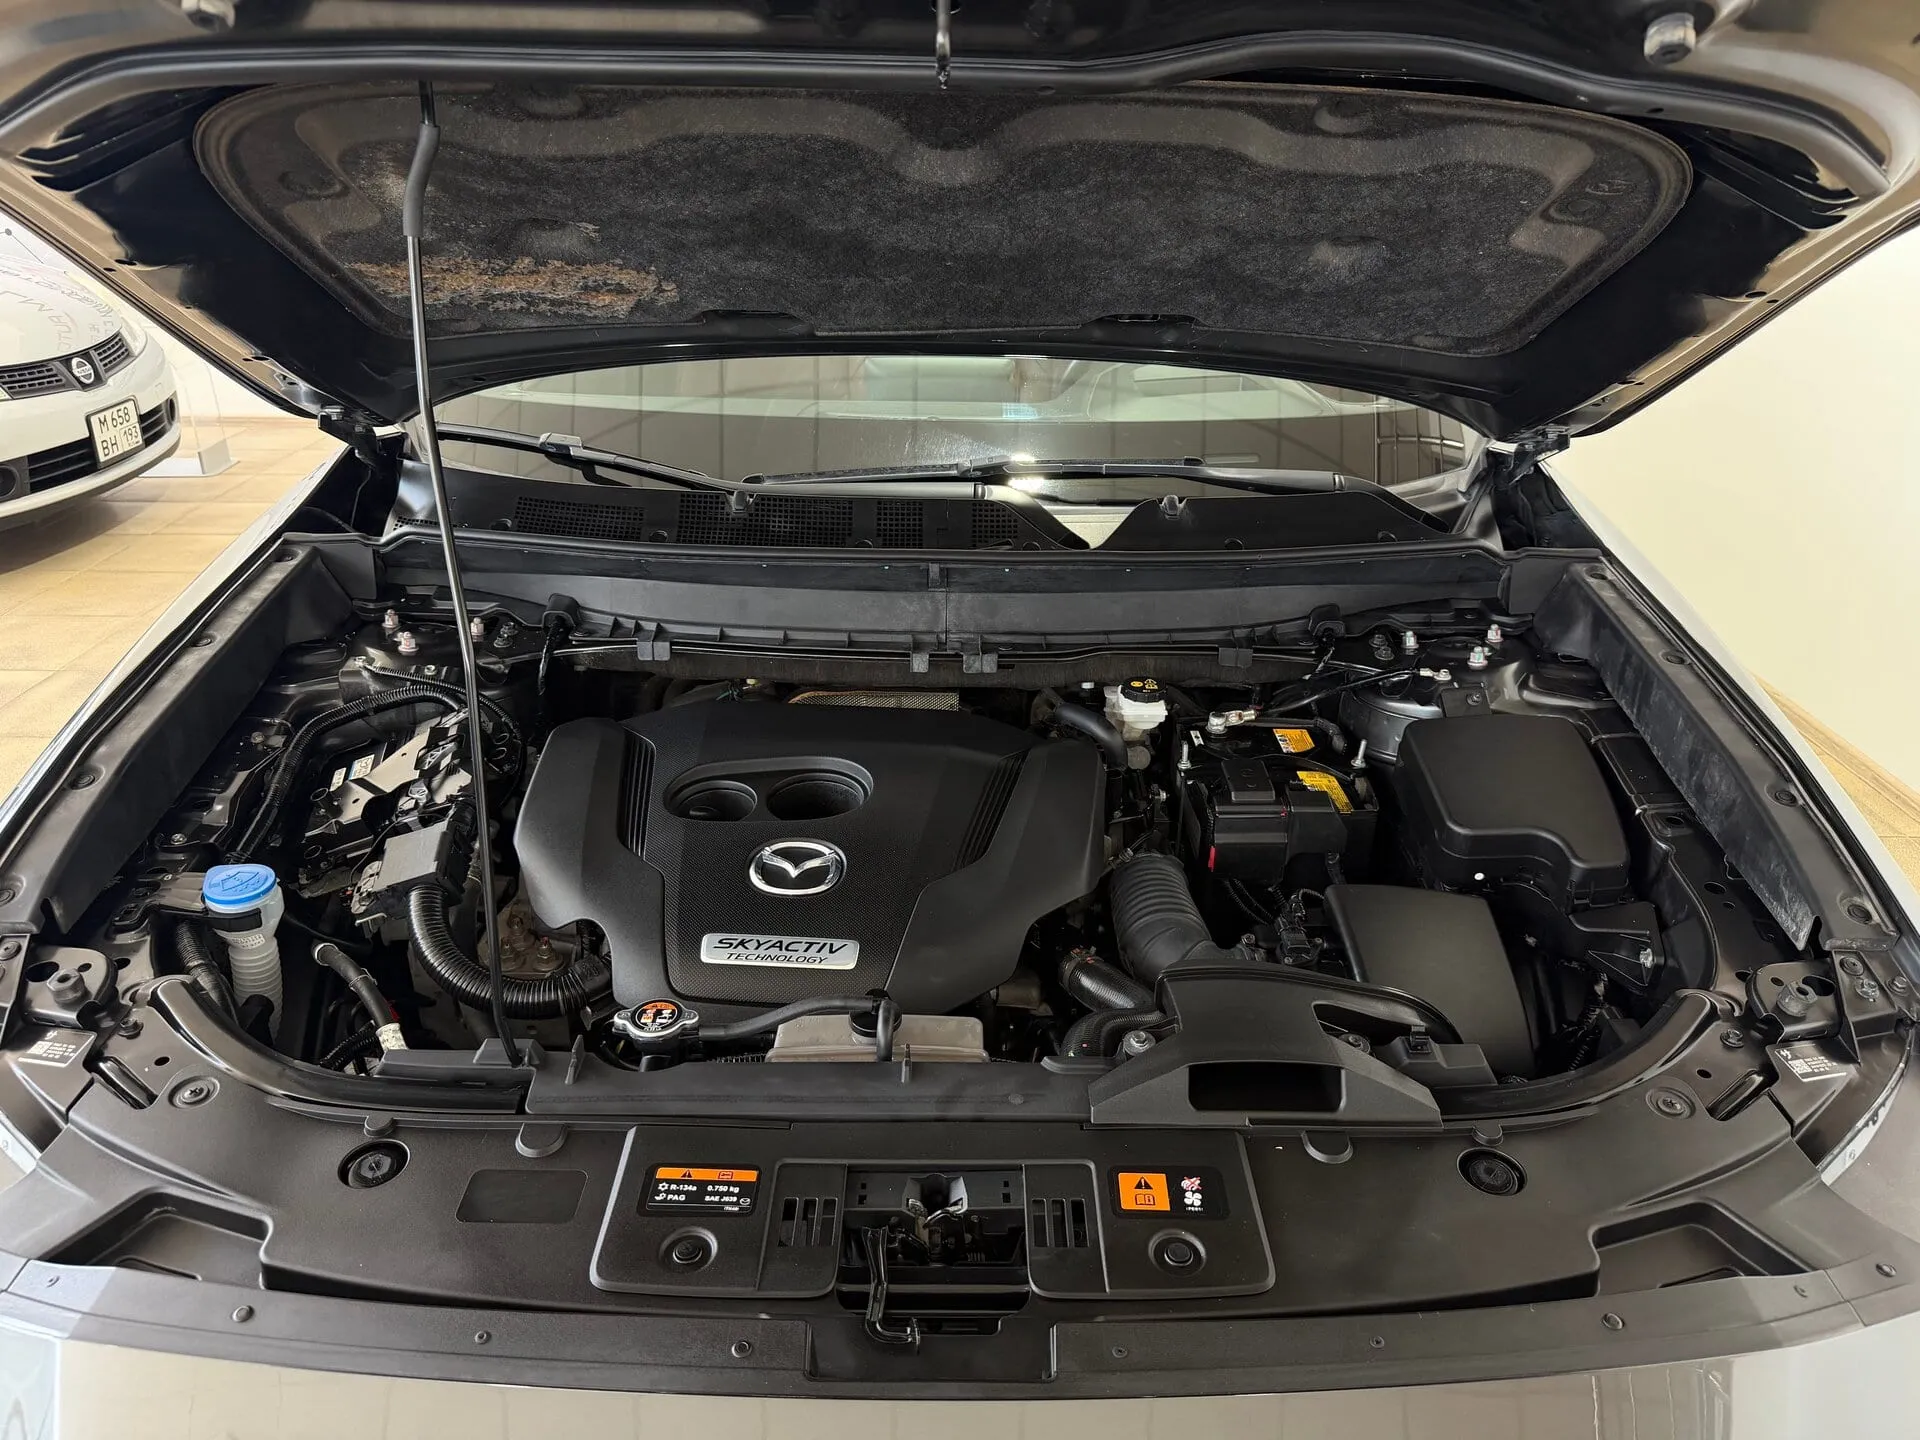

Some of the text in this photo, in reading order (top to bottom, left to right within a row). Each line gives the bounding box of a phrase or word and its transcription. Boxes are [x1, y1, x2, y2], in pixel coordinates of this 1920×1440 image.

[111, 406, 131, 428] 658
[123, 425, 139, 442] 193
[713, 938, 848, 955] SKYACTIV
[726, 952, 828, 964] TECHNOLOGY
[670, 1184, 697, 1192] R-134a
[729, 1186, 740, 1194] kg
